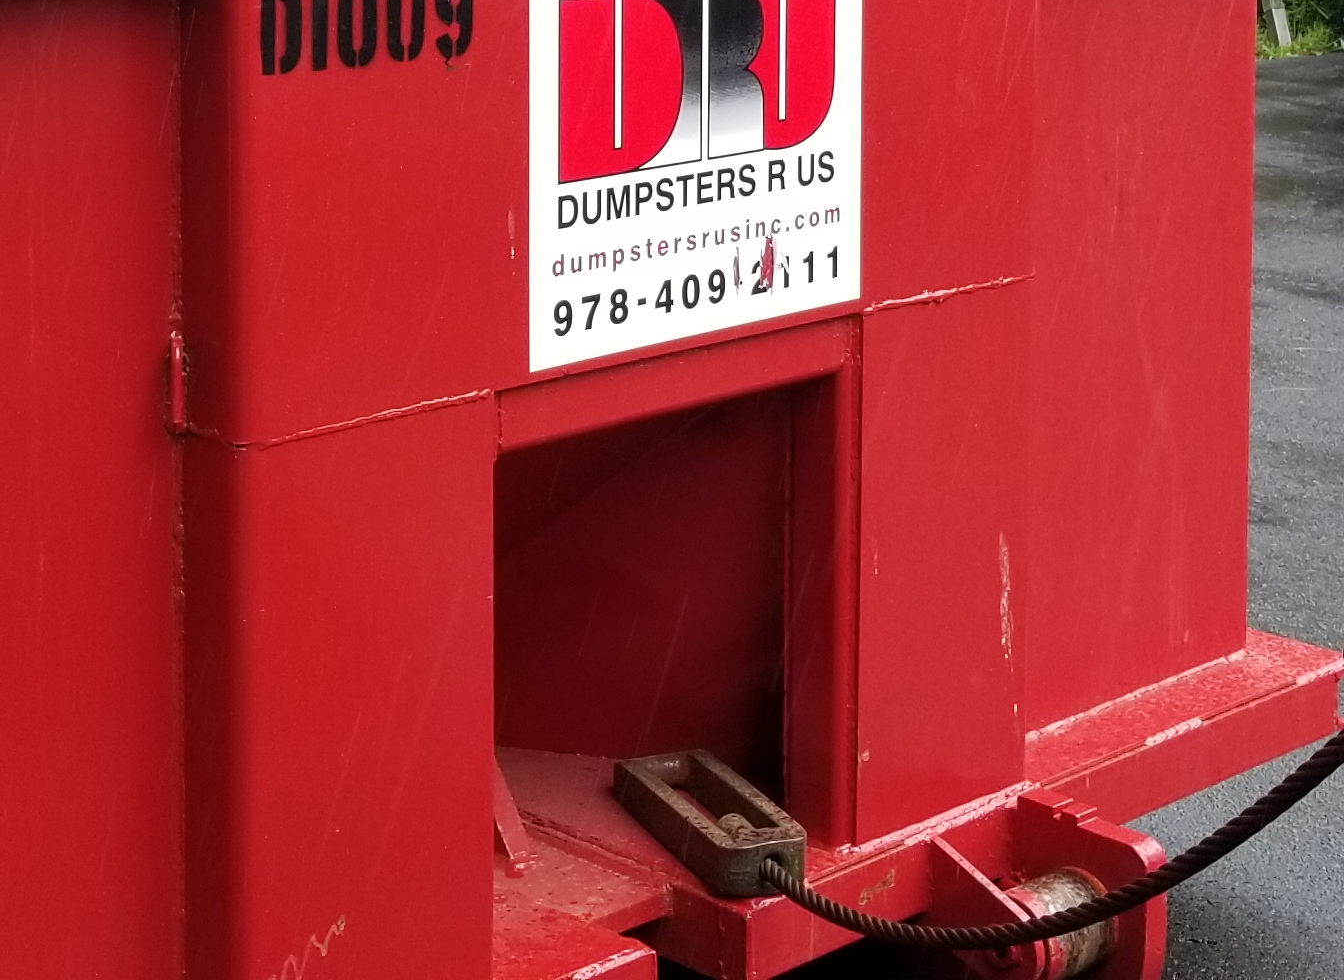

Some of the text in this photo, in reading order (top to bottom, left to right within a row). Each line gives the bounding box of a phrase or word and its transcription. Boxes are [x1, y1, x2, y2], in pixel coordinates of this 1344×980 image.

[558, 151, 834, 229] DUMPSTERS R US
[552, 207, 840, 276] dumpstersrusinc.com
[554, 246, 838, 336] 978-4092111
